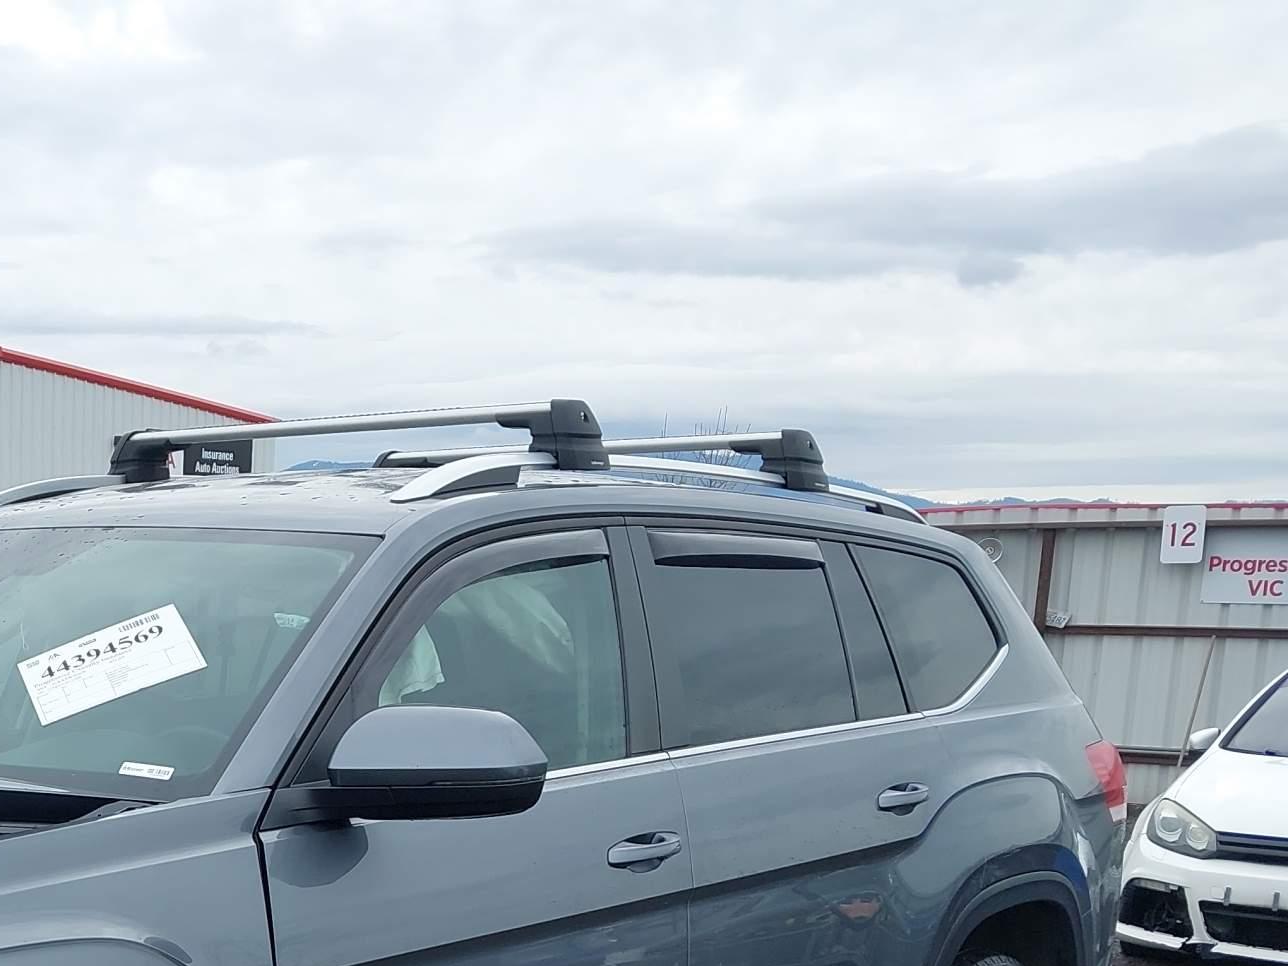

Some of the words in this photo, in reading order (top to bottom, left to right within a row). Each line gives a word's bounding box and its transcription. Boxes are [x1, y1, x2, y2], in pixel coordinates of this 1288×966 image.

[201, 447, 234, 461] Insurance
[194, 461, 211, 473] Auto
[211, 462, 240, 475] Auctions
[1170, 522, 1197, 547] 12
[1208, 555, 1288, 576] Progres
[1248, 579, 1284, 597] VIC
[41, 625, 164, 679] 44394569
